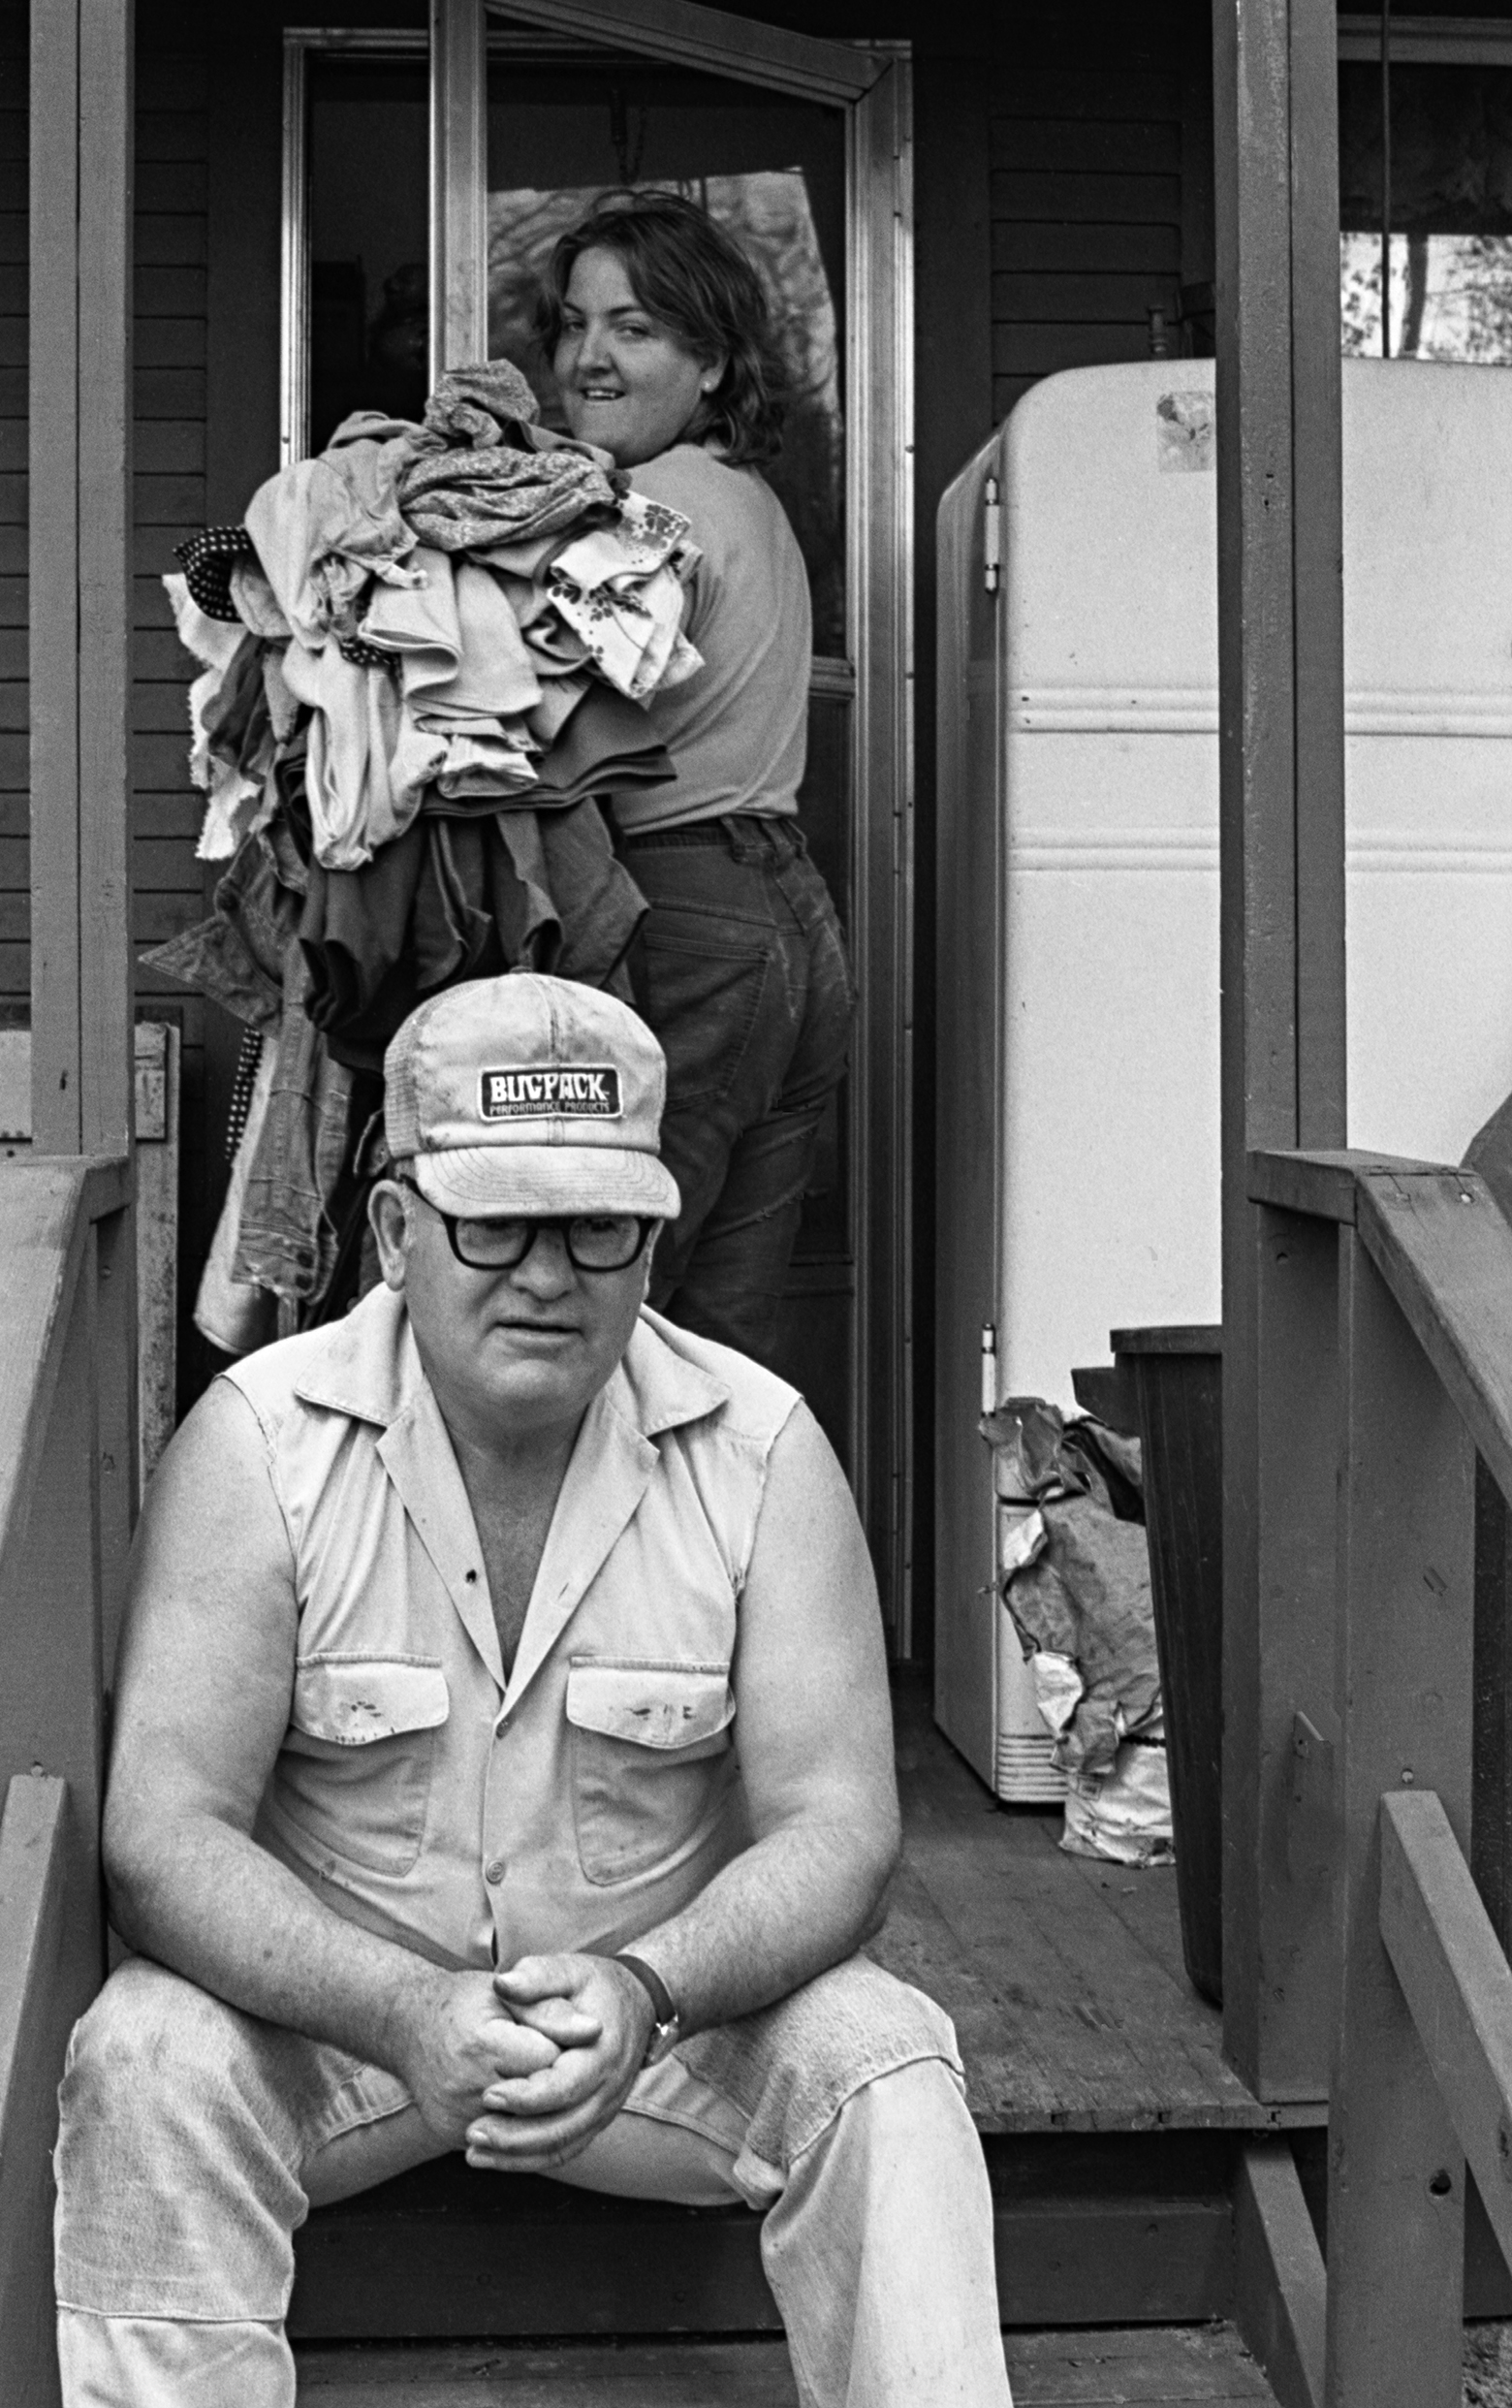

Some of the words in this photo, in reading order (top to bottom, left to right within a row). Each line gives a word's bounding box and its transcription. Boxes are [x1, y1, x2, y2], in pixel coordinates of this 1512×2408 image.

[489, 1073, 608, 1102] BUGPACK
[489, 1101, 560, 1116] PERFORMANCE
[564, 1101, 611, 1113] PRODUCTS
